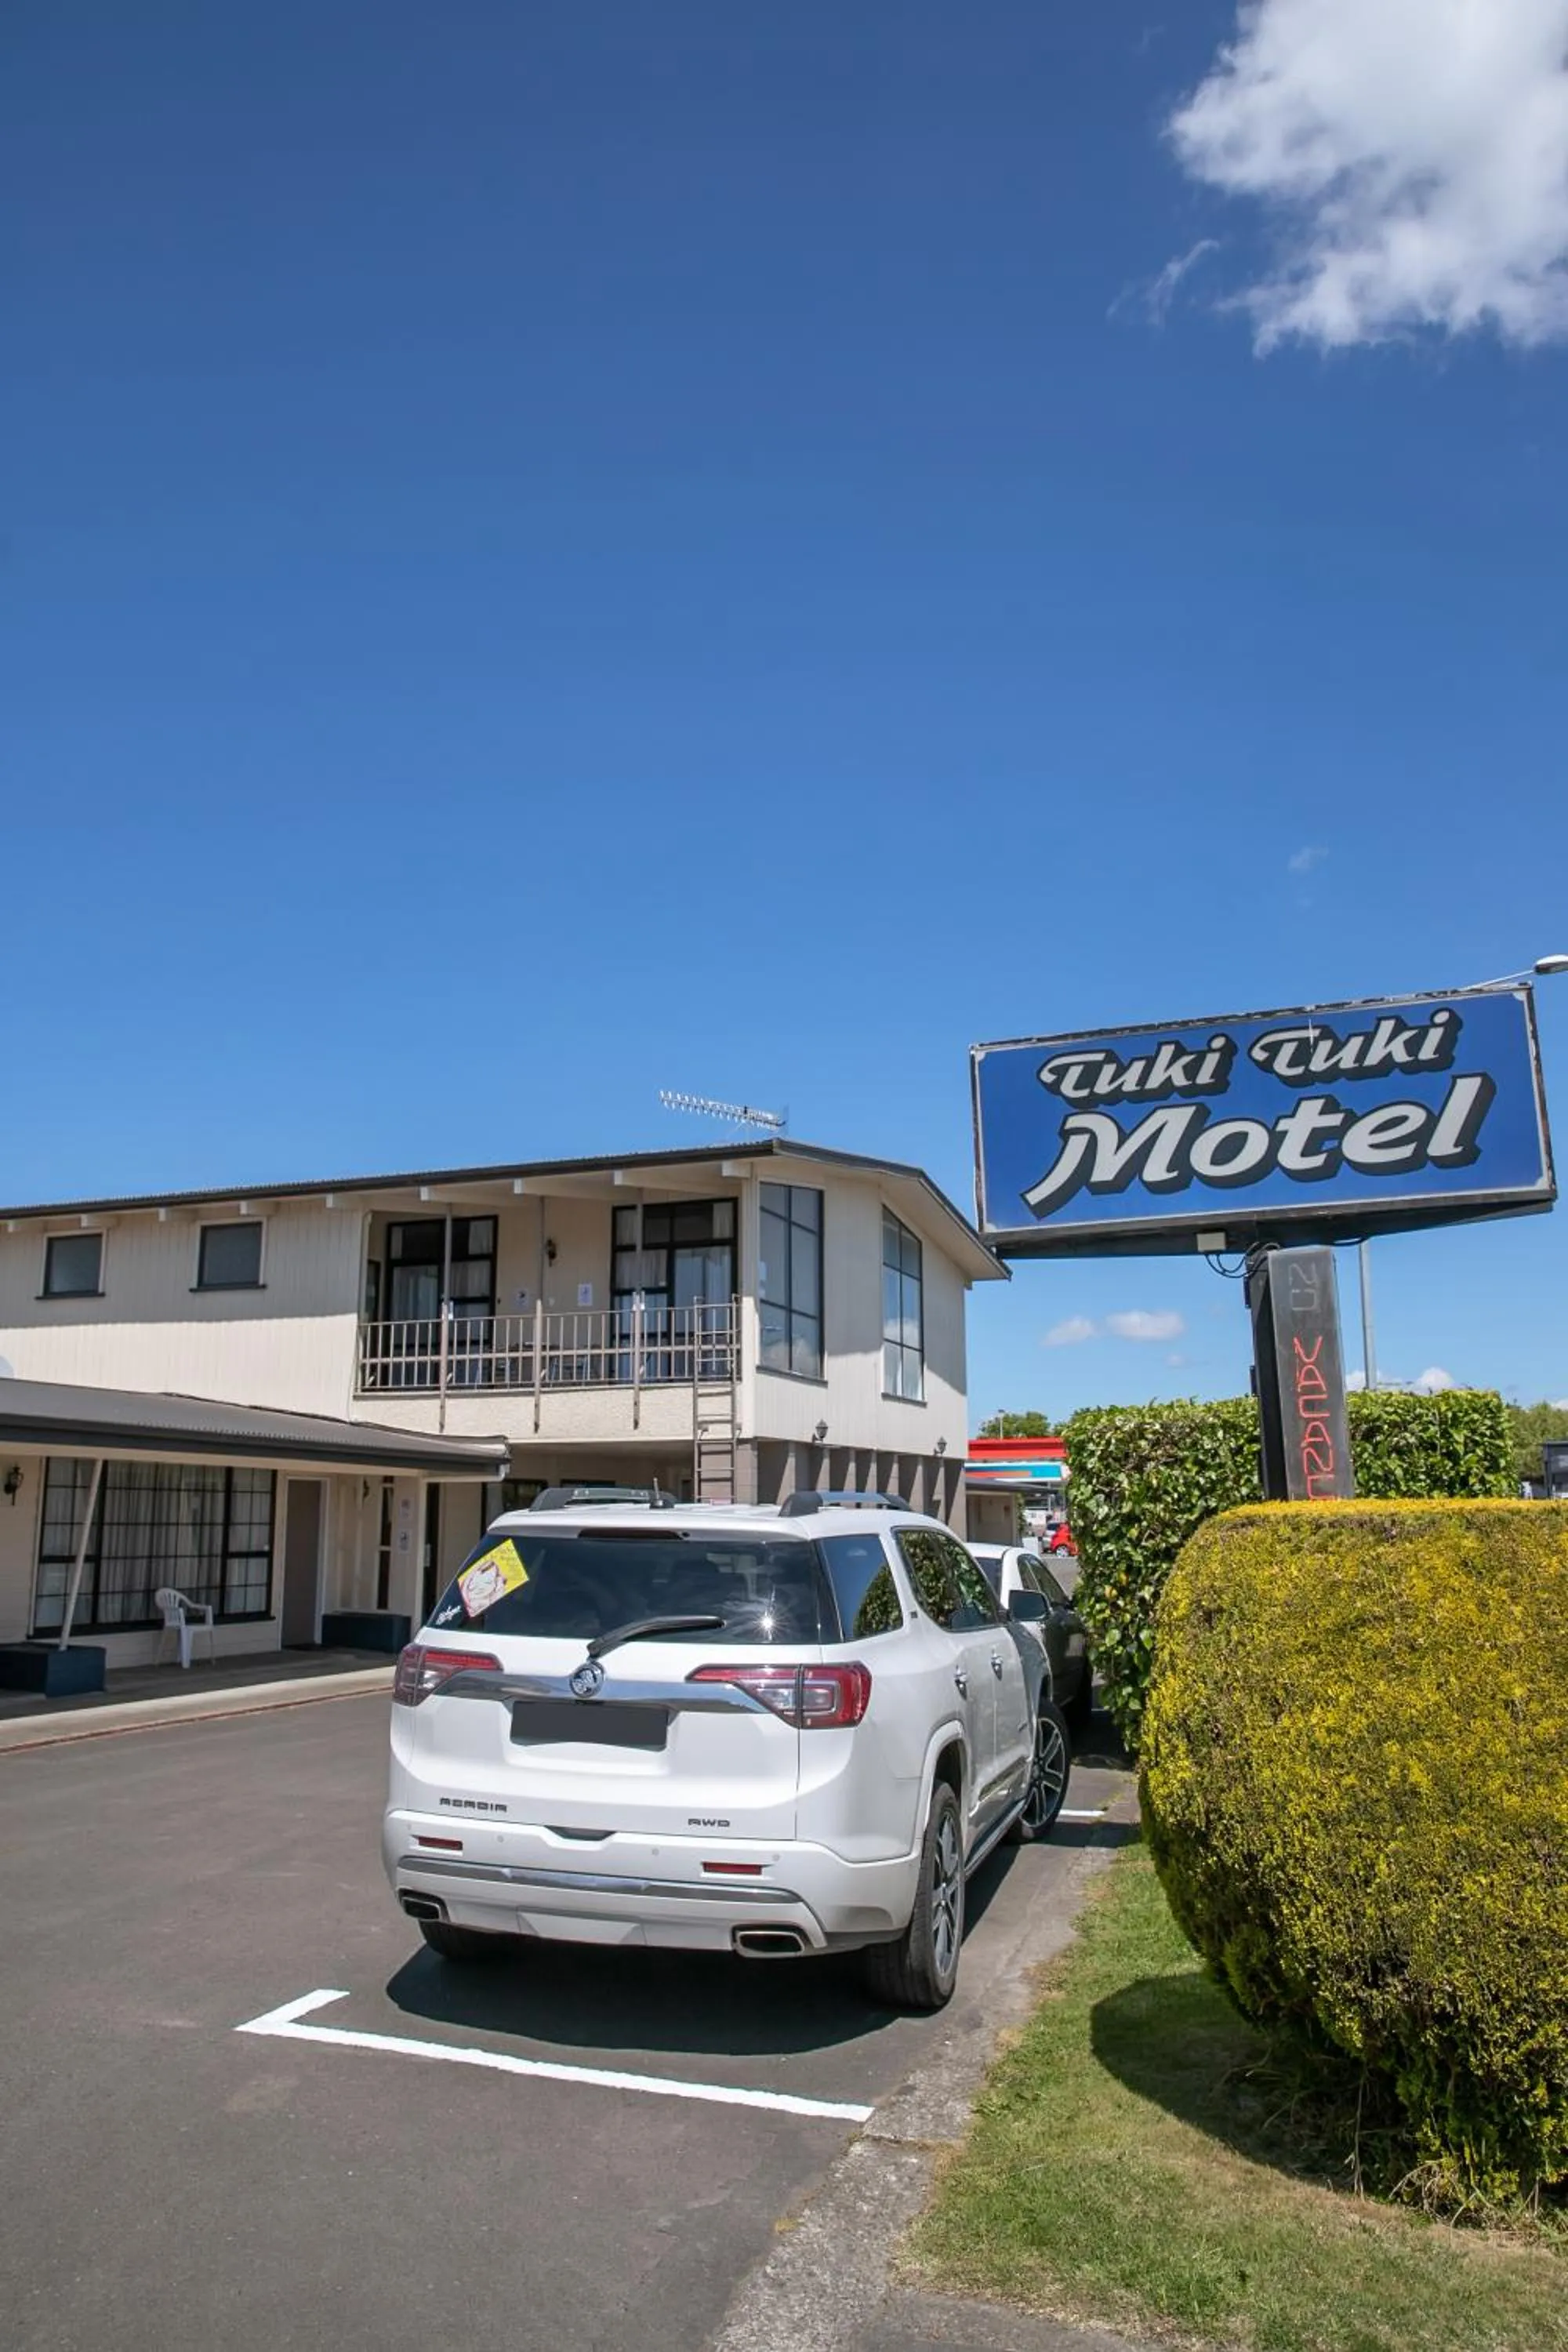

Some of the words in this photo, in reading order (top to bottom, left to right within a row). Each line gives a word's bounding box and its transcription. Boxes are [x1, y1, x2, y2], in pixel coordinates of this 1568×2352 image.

[1040, 1036, 1229, 1094] Tuki
[1251, 1009, 1450, 1076] Tuki
[1021, 1076, 1483, 1207] Motel
[1293, 1335, 1336, 1500] VACANC
[688, 1818, 730, 1828] AWD
